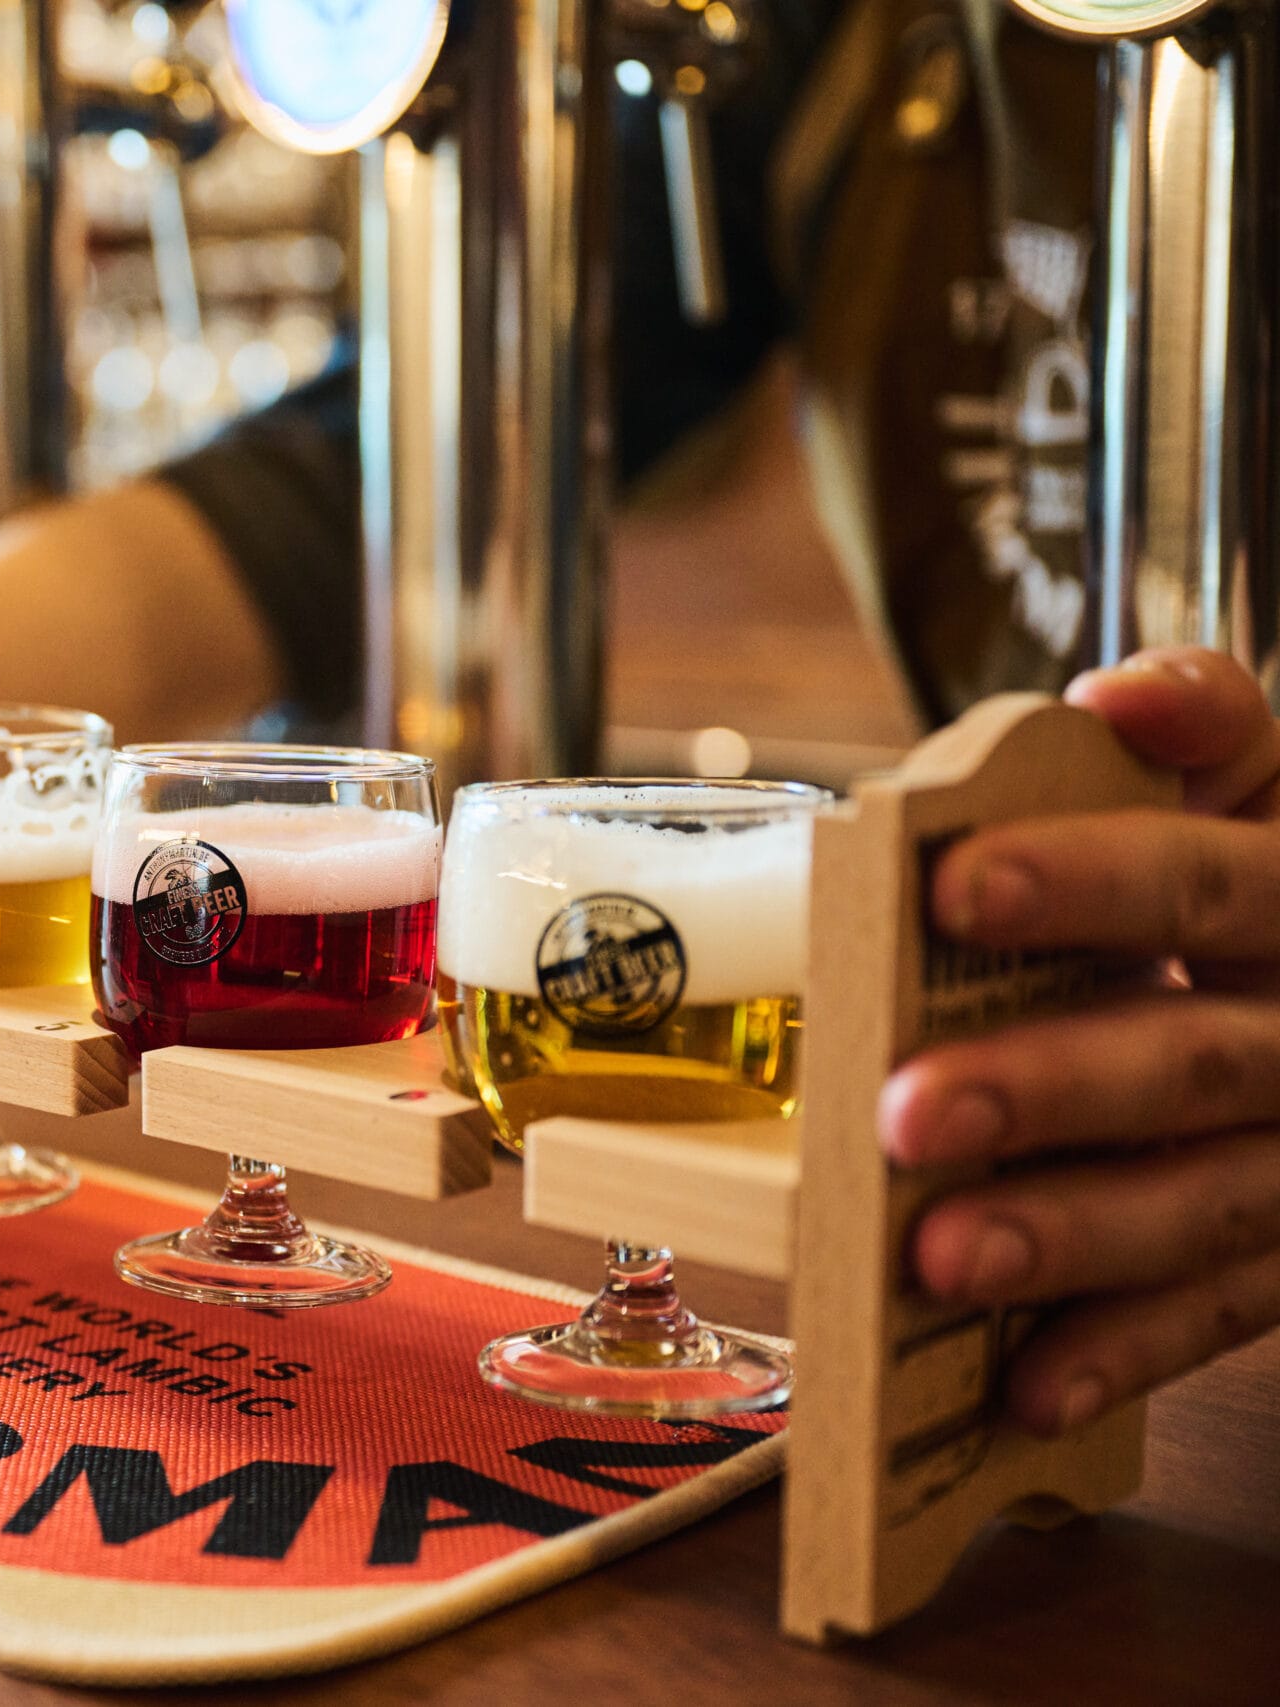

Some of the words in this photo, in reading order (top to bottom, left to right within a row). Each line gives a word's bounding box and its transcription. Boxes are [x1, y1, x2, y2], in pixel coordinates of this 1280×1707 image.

[140, 901, 189, 937] CRAFT
[190, 885, 241, 919] BEER
[32, 1291, 313, 1383] WORLD'S
[37, 1333, 297, 1418] LAMBIC
